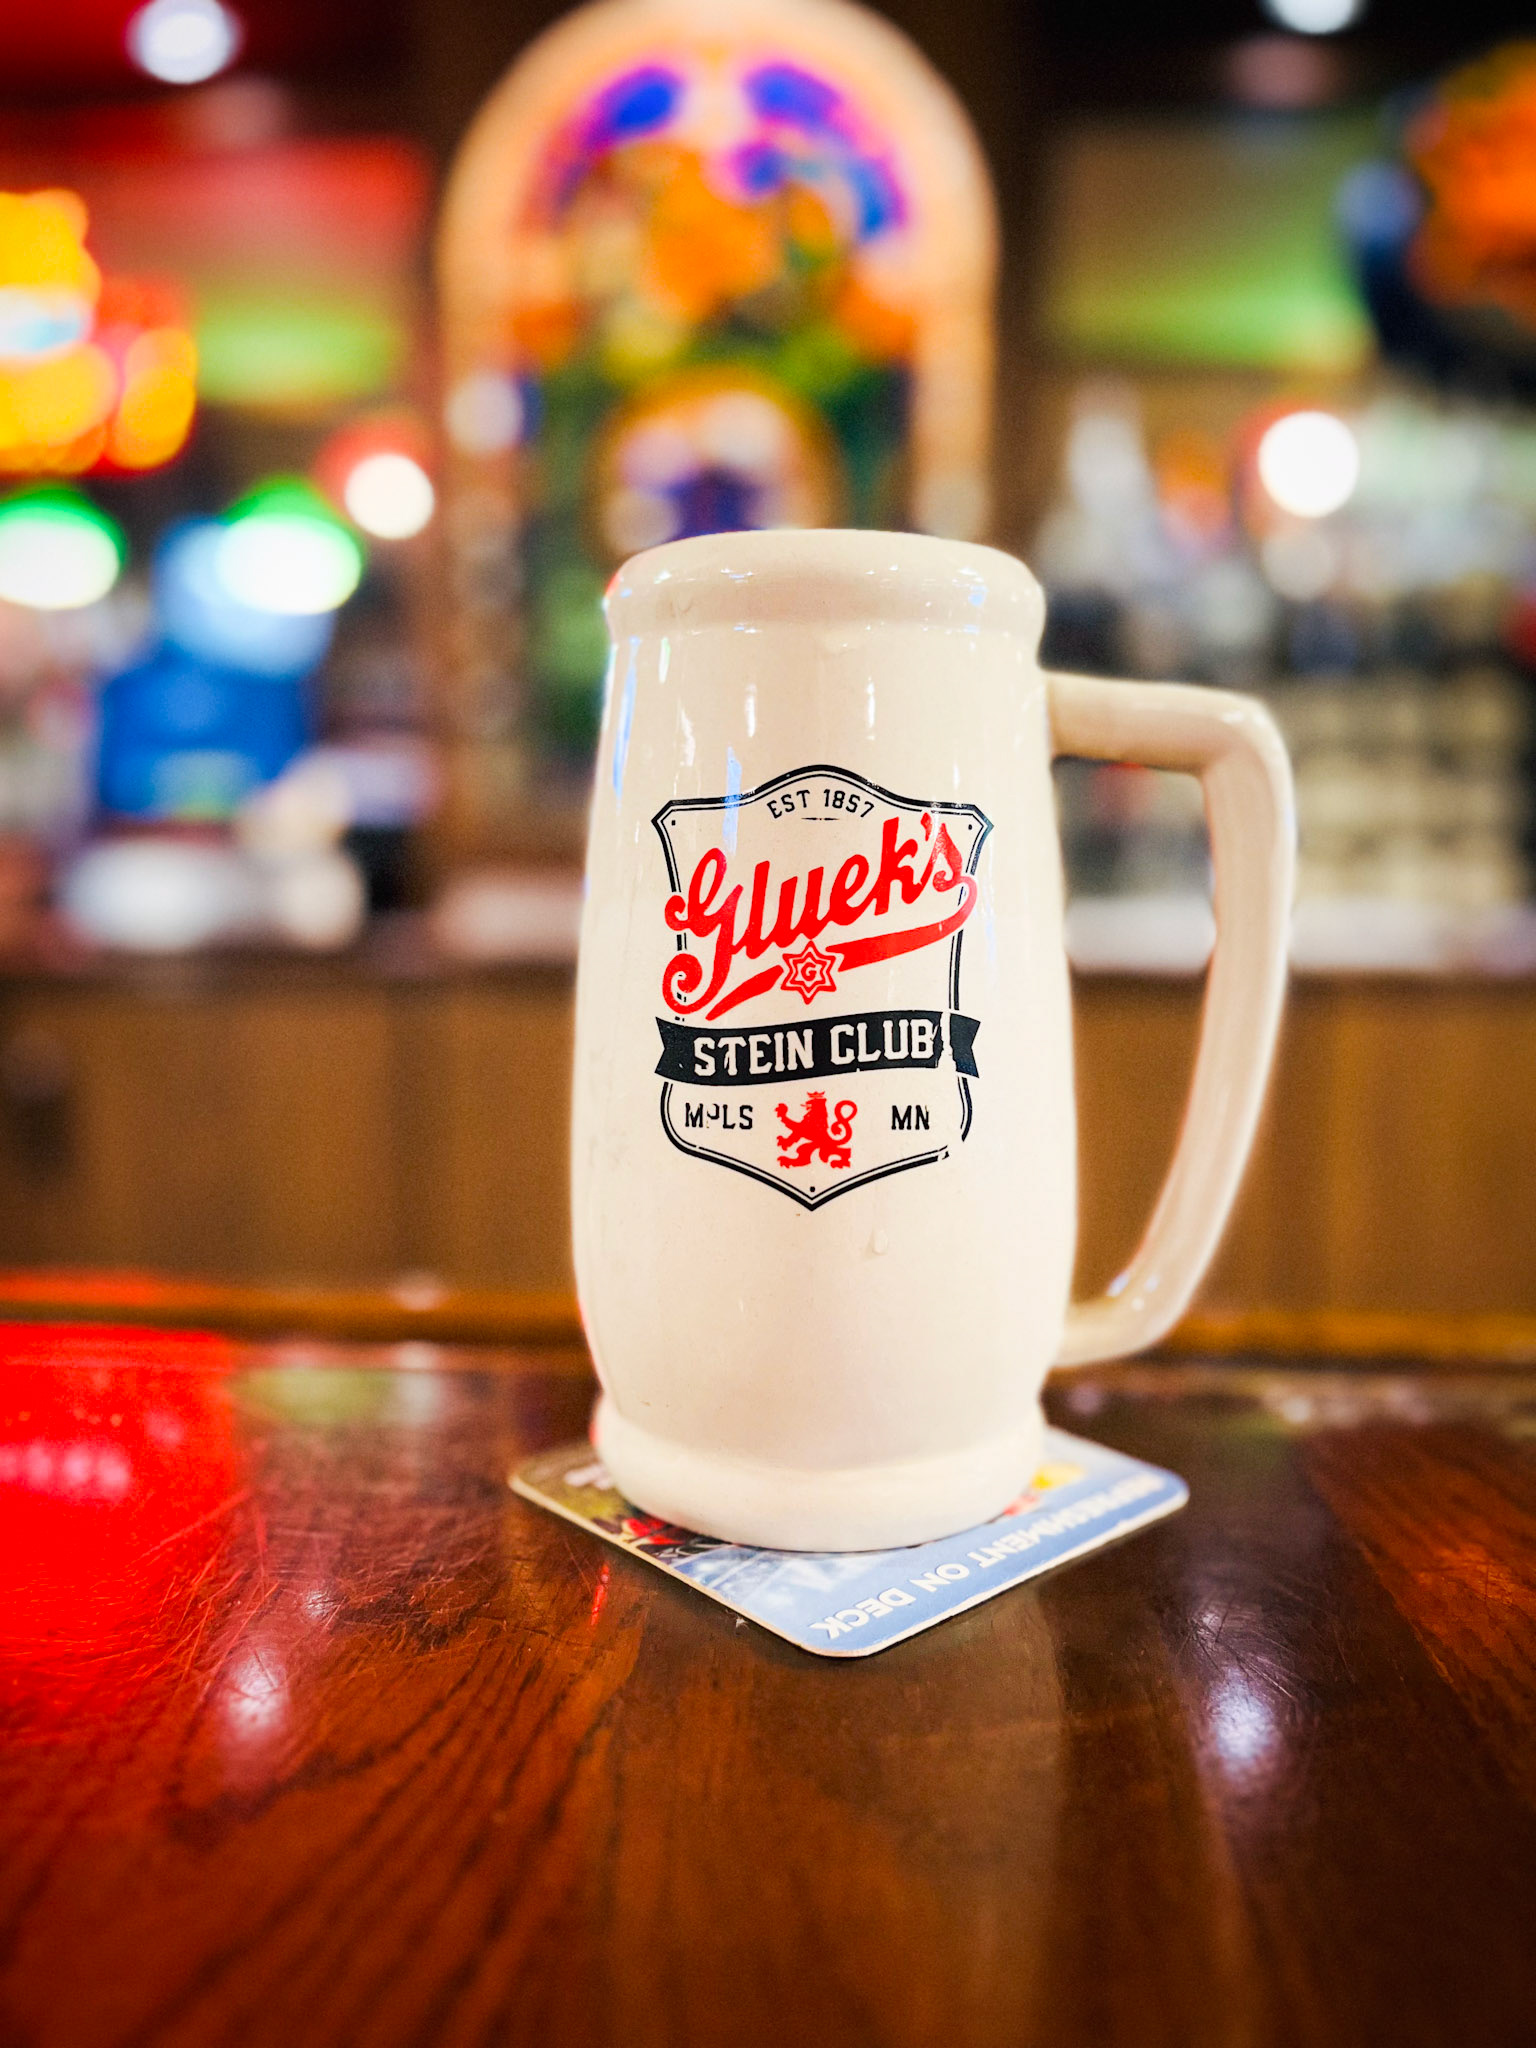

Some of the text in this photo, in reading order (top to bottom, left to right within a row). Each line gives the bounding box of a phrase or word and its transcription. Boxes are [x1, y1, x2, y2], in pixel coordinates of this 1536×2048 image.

[766, 788, 875, 819] EST 1857
[662, 811, 978, 1016] Gluek's
[800, 961, 817, 982] G
[693, 1018, 936, 1077] STEIN CLUB
[891, 1104, 930, 1131] MN
[909, 1563, 971, 1593] ON
[808, 1587, 917, 1640] DECK
